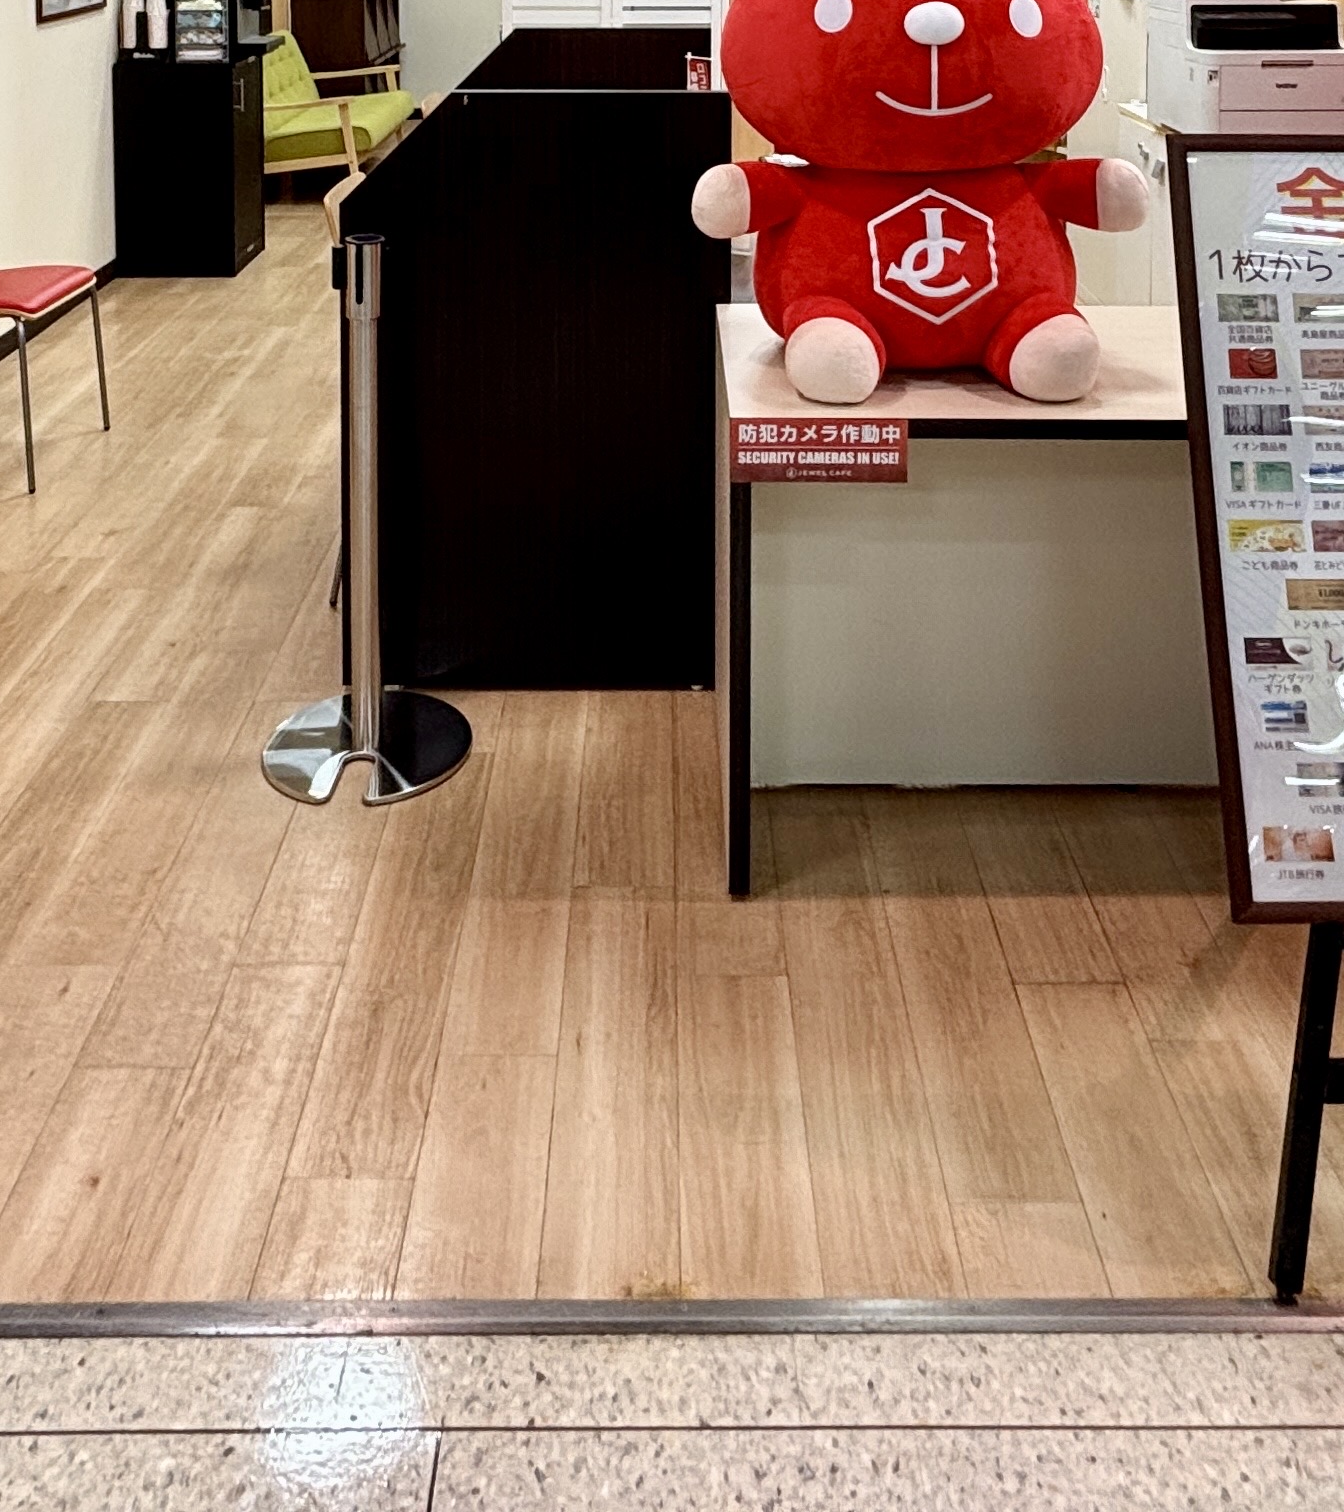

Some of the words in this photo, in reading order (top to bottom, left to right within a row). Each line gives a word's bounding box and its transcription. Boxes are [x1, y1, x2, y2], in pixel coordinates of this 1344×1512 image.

[738, 424, 900, 444] 防犯カメラ作動中
[738, 451, 796, 465] SECURITY
[797, 451, 855, 465] CAMERAS
[857, 452, 871, 464] IN
[872, 452, 899, 465] USE!
